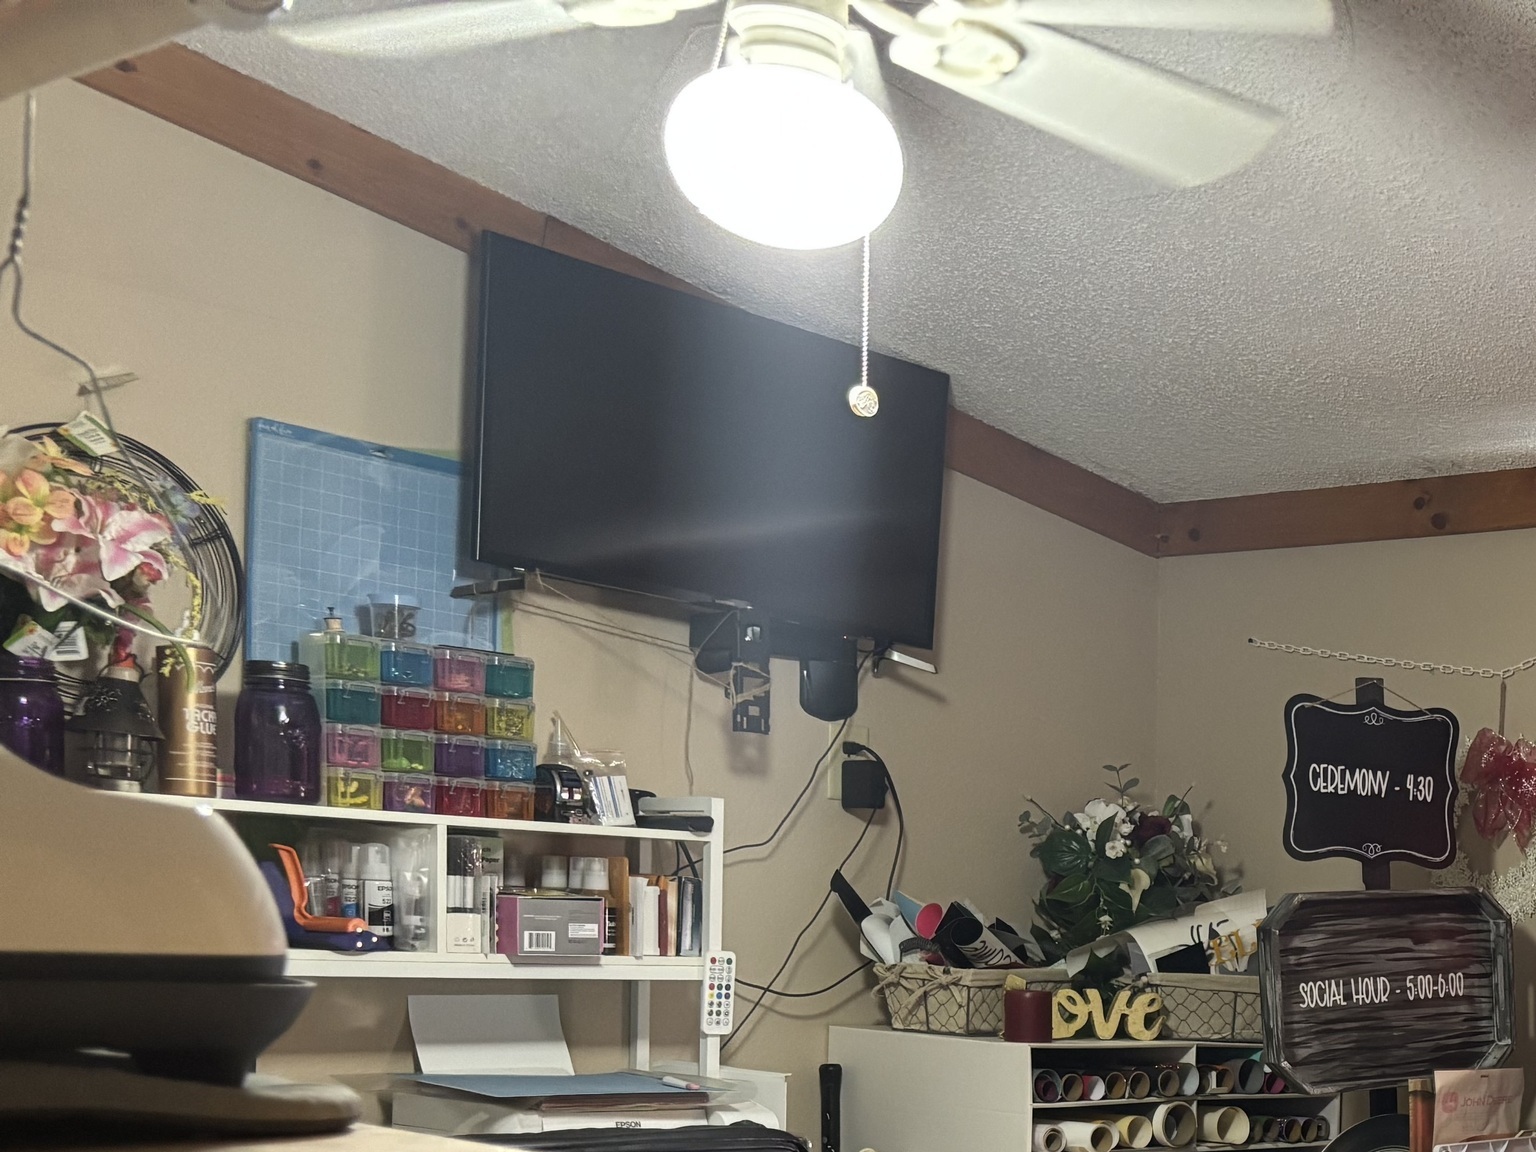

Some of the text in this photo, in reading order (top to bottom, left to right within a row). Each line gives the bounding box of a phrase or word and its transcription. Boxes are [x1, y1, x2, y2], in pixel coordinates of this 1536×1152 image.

[1309, 763, 1390, 798] CEREMONY
[1406, 773, 1434, 802] 4:30
[1299, 979, 1348, 1008] SOCIAL
[1350, 976, 1391, 1006] HOUR
[1406, 971, 1464, 1001] 5:00-6:00
[1051, 987, 1168, 1041] ove
[1460, 1097, 1485, 1107] JOHN
[615, 1120, 642, 1129] EPSON
